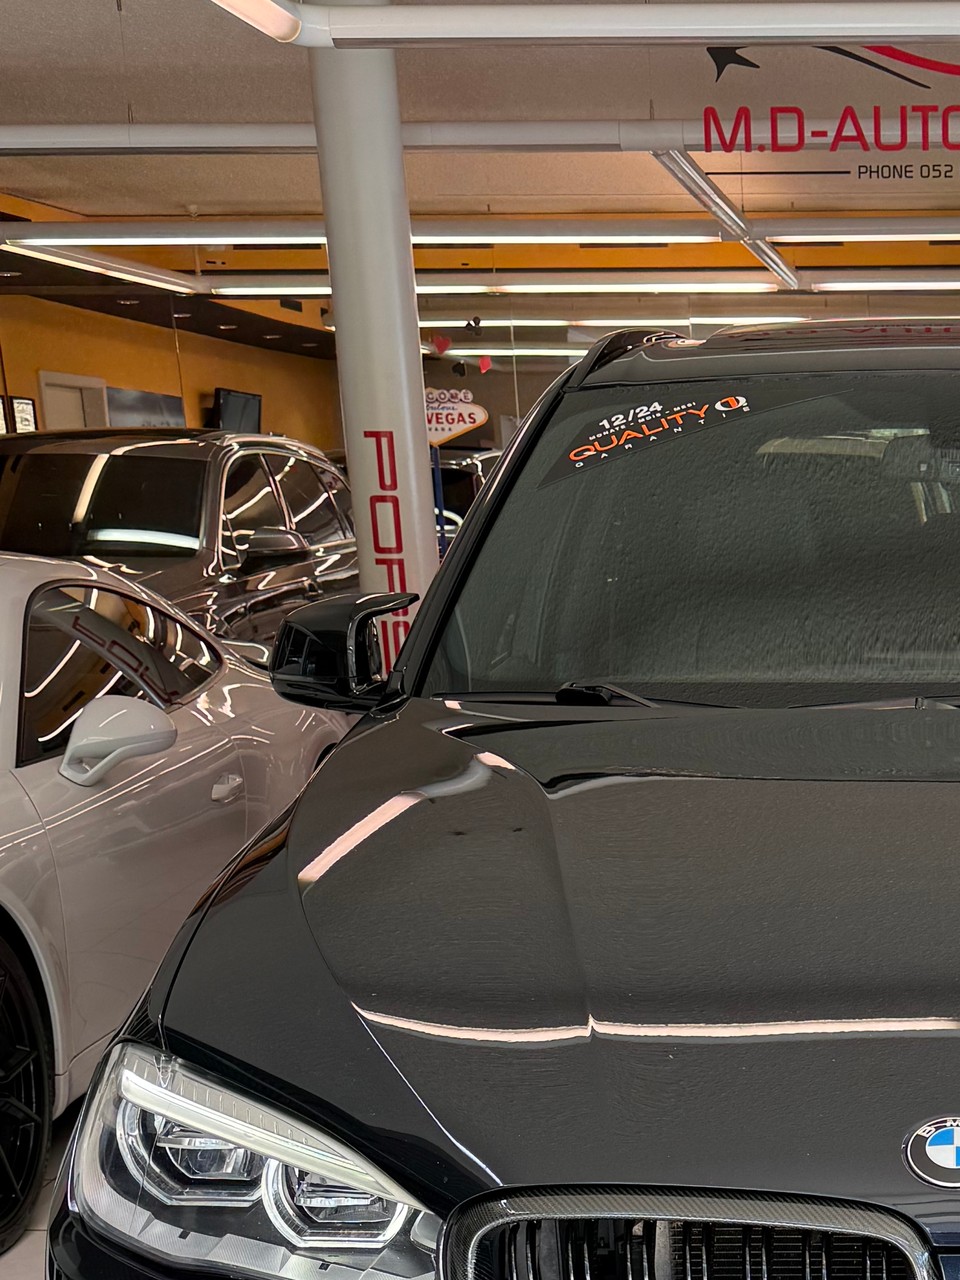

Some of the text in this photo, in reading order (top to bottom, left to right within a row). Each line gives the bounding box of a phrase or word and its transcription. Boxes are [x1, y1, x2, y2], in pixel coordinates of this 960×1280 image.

[857, 164, 914, 179] PHONE
[919, 164, 954, 178] 052
[427, 412, 477, 425] VEGAS
[598, 401, 663, 430] 12/24
[568, 404, 710, 461] QUALITY
